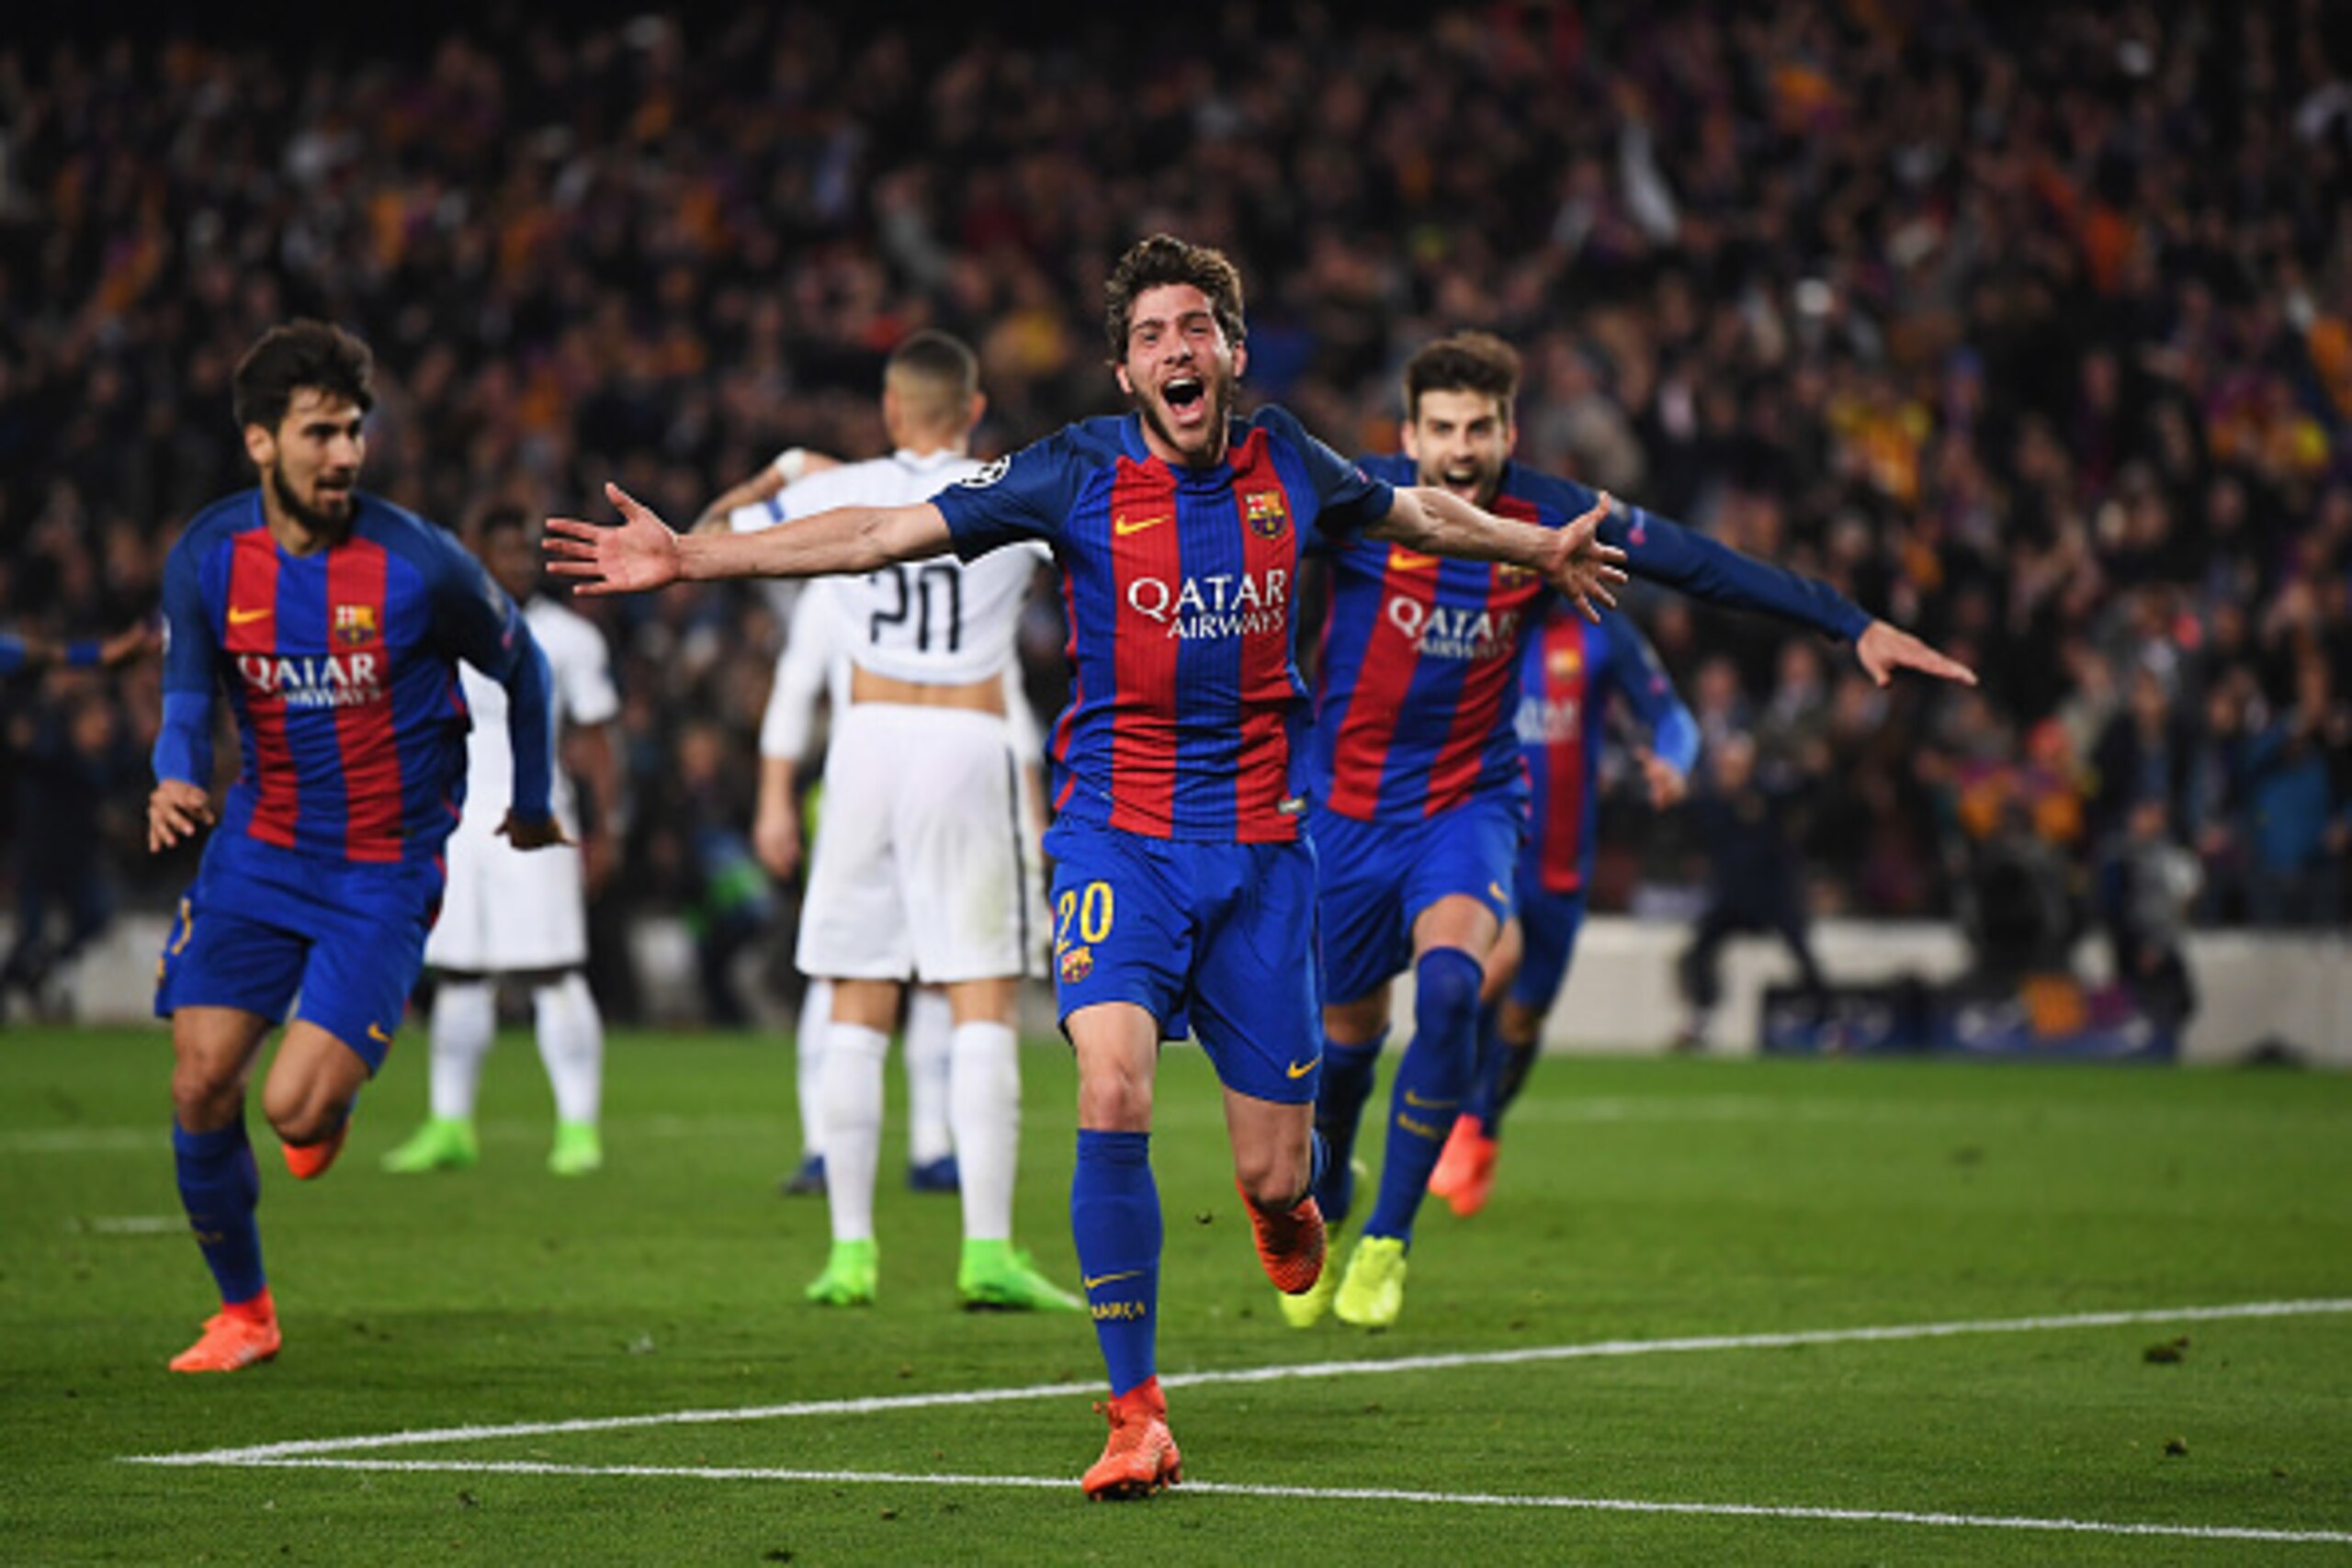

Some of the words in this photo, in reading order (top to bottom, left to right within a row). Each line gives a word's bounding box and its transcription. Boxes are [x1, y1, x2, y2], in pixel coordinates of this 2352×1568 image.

[1127, 569, 1287, 623] QATAR
[1388, 596, 1519, 638] QATAR
[1166, 605, 1284, 638] AIRWAYS
[237, 652, 378, 692] QATAR
[1056, 880, 1114, 954] 20
